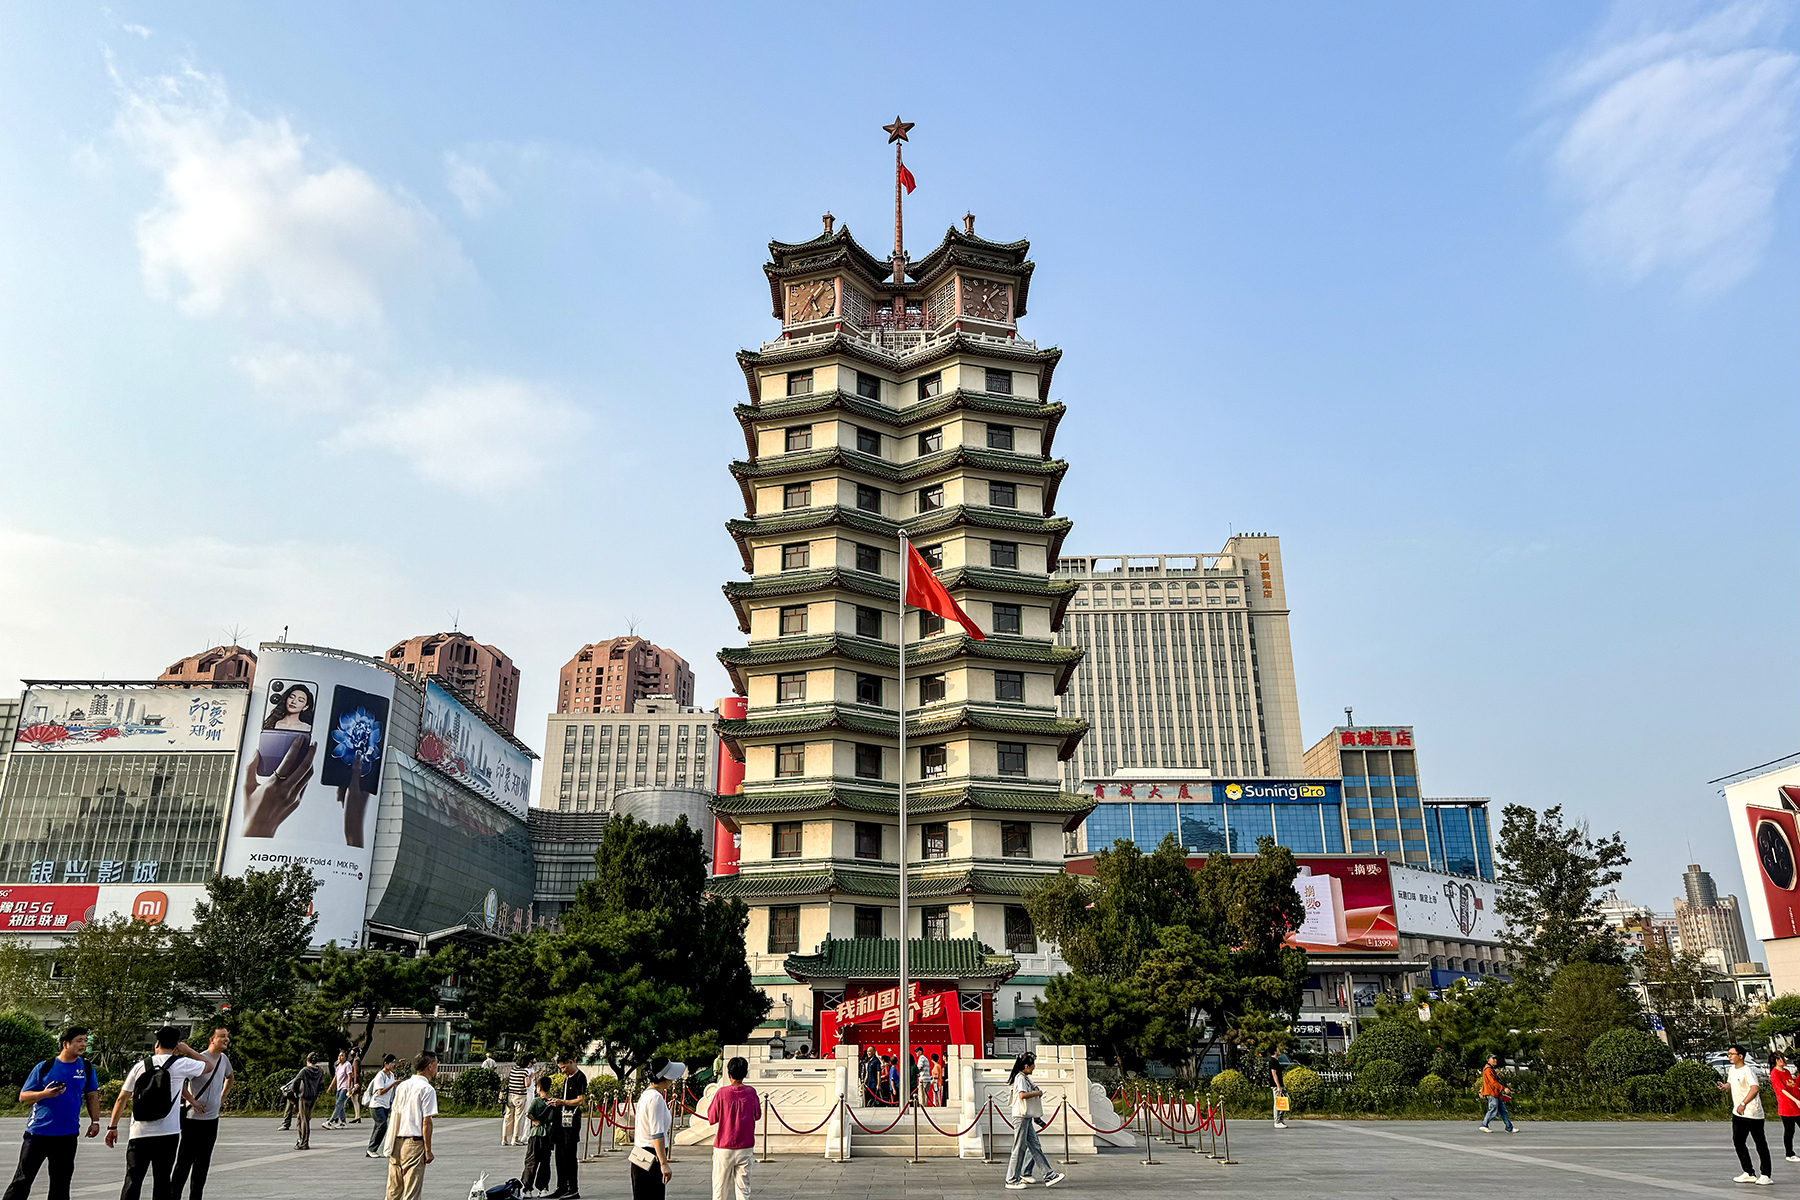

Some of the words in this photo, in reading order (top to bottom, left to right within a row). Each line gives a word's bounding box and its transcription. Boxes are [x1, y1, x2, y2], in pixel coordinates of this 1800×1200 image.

[189, 724, 222, 741] 郑州
[1339, 730, 1412, 747] 商城酒店
[1093, 783, 1194, 800] 商城大厦
[1244, 785, 1298, 799] Suning
[1301, 786, 1325, 798] Pro
[310, 858, 325, 866] Fold
[336, 860, 349, 868] MIX
[30, 860, 159, 884] 银兴影城
[8, 914, 68, 927] 郑选联通
